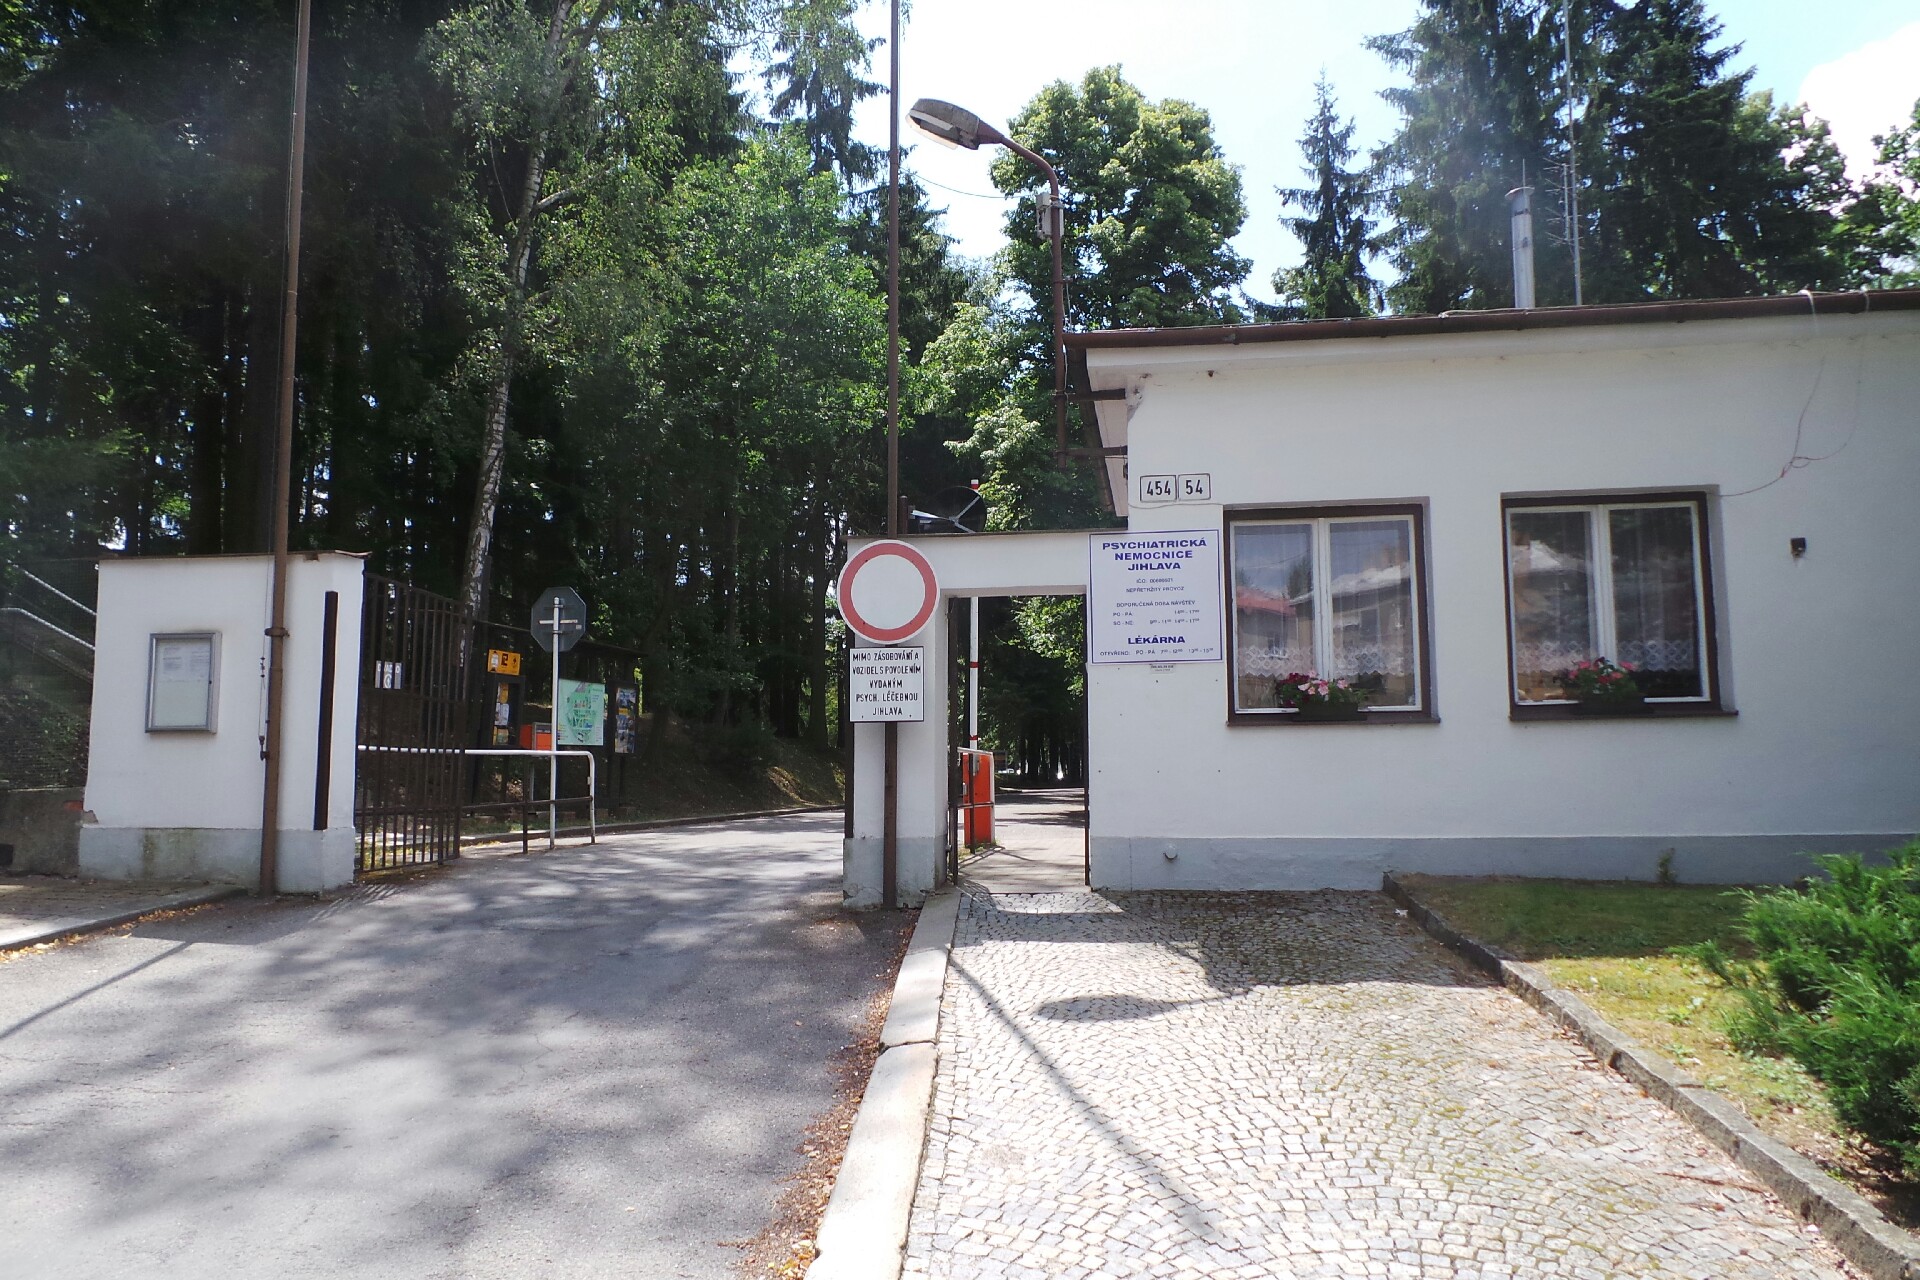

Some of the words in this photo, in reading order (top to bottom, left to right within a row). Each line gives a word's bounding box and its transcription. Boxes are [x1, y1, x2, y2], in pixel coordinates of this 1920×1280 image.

[1146, 480, 1171, 496] 454
[1185, 479, 1203, 495] 54
[1102, 537, 1207, 550] PSYCHIATRICKÁ
[1114, 550, 1193, 561] NEMOCNICE
[1128, 562, 1181, 571] JIHLAVA
[1128, 635, 1185, 644] LÉKÁRNA
[852, 653, 871, 661] MIMO
[874, 650, 913, 661] ZÁSOBOVÁNÍ
[915, 652, 919, 660] A
[852, 666, 878, 675] VOZIDEL
[880, 666, 884, 674] S
[885, 663, 921, 674] POVOLENÍM
[870, 678, 903, 689] VYDANÝM
[856, 693, 880, 702] PSYCH.
[883, 690, 918, 702] LÉČEBNOU
[873, 707, 903, 716] JIHLAVA
